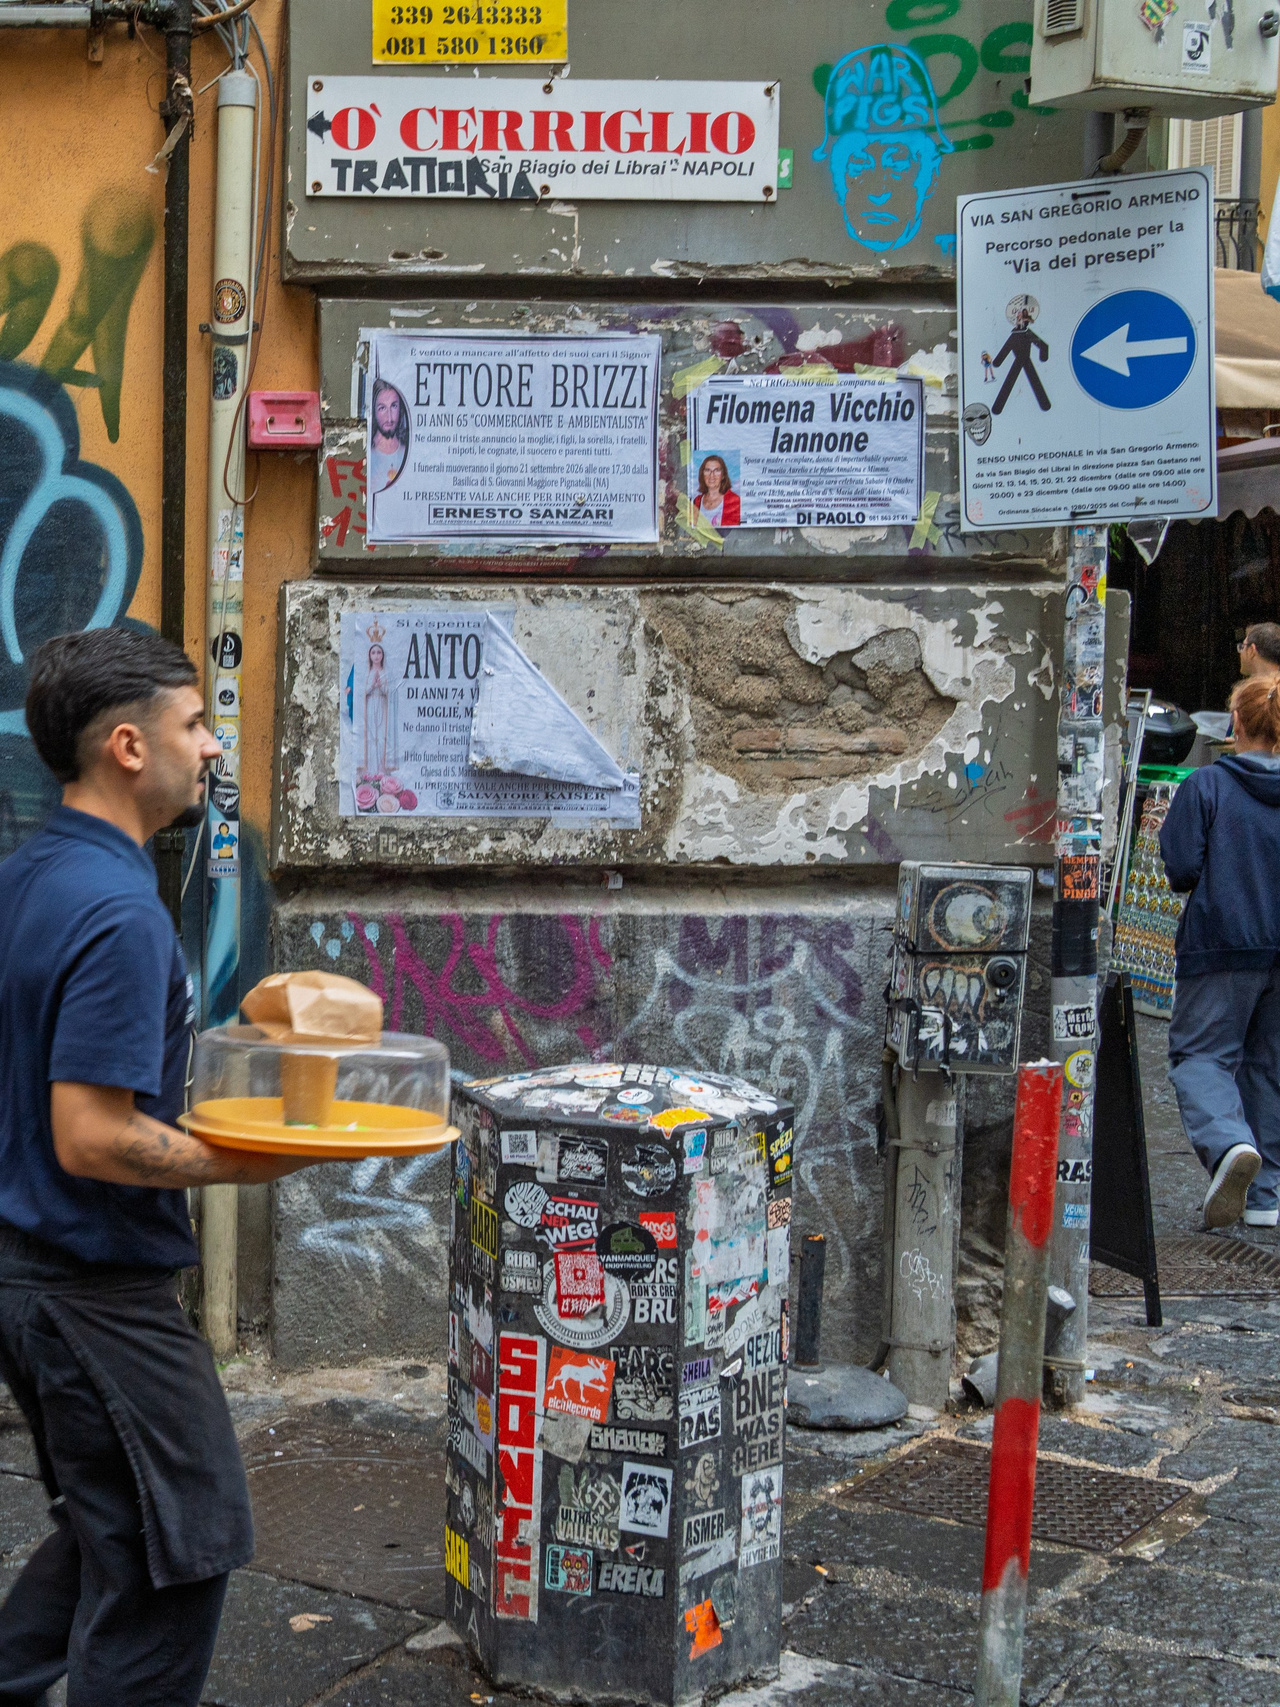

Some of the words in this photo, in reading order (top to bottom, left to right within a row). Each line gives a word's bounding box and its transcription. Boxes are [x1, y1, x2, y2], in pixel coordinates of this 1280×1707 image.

[390, 5, 433, 25] 339
[442, 5, 543, 25] 2643333
[436, 36, 480, 56] 580
[488, 36, 543, 56] 1360
[834, 52, 923, 101] WAR
[833, 92, 930, 132] PIGS
[399, 105, 756, 157] CERRIGLIO
[479, 158, 513, 175] San
[519, 159, 577, 179] Biagio
[581, 159, 610, 176] dei
[614, 160, 666, 176] Librai
[682, 160, 755, 177] NAPOLI
[970, 213, 995, 228] VIA
[1000, 208, 1034, 224] SAN
[1039, 197, 1123, 219] GREGORIO
[1127, 188, 1200, 209] ARMENO
[985, 237, 1053, 255] Percorso
[1058, 226, 1131, 249] pedonale
[1137, 224, 1164, 240] per
[1169, 219, 1185, 233] la
[1004, 257, 1041, 274] “Via
[1048, 252, 1077, 271] dei
[1084, 242, 1165, 269] presepi”
[419, 349, 452, 358] venuto
[462, 349, 503, 358] mancare
[552, 349, 567, 359] dei
[620, 350, 652, 361] Signor
[414, 362, 534, 408] ETTORE
[550, 363, 649, 409] BRIZZI
[706, 394, 816, 424] Filomena
[830, 391, 916, 422] Vicchio
[416, 412, 427, 428] DI
[428, 412, 455, 428] ANNI
[456, 413, 468, 428] 65
[557, 414, 564, 429] E
[770, 426, 869, 453] Iannone
[976, 455, 1006, 465] SENSO
[1008, 453, 1036, 463] UNICO
[1038, 449, 1084, 460] PEDONALE
[1086, 448, 1094, 456] in
[1096, 447, 1108, 456] via
[1110, 446, 1126, 455] San
[1128, 443, 1164, 453] Gregorio
[417, 462, 445, 473] funerali
[445, 463, 489, 474] muoveranno
[495, 463, 519, 476] giorno
[520, 463, 529, 474] 21
[530, 463, 565, 475] settembre
[565, 463, 584, 475] 2026
[584, 463, 597, 475] alle
[598, 465, 611, 475] ore
[631, 464, 649, 475] dalla
[403, 491, 413, 501] IL
[415, 491, 467, 501] PRESENTE
[469, 491, 495, 502] VALE
[496, 492, 531, 502] ANCHE
[533, 492, 553, 502] PER
[432, 507, 523, 519] ERNESTO
[529, 508, 614, 520] SANZARI
[796, 512, 812, 525] DI
[816, 511, 866, 525] PAOLO
[396, 619, 410, 628] Si
[427, 620, 481, 630] spenta
[407, 687, 419, 700] DI
[421, 687, 449, 700] ANNI
[451, 688, 465, 700] 74
[457, 791, 541, 800] SALVATORE
[544, 791, 606, 801] KAISER
[541, 1213, 570, 1228] NED
[545, 1201, 599, 1222] SCHAU
[545, 1222, 599, 1245] WEG!
[600, 1254, 657, 1263] VANMARQUEE
[631, 1284, 658, 1298] RON'S
[683, 1361, 711, 1383] SHEILA
[735, 1367, 782, 1421] BNE
[680, 1405, 721, 1447] RAS
[736, 1413, 780, 1443] WAS
[557, 1521, 619, 1550] VALLEKAS
[685, 1512, 724, 1547] ASMER
[598, 1561, 665, 1598] EREKA
